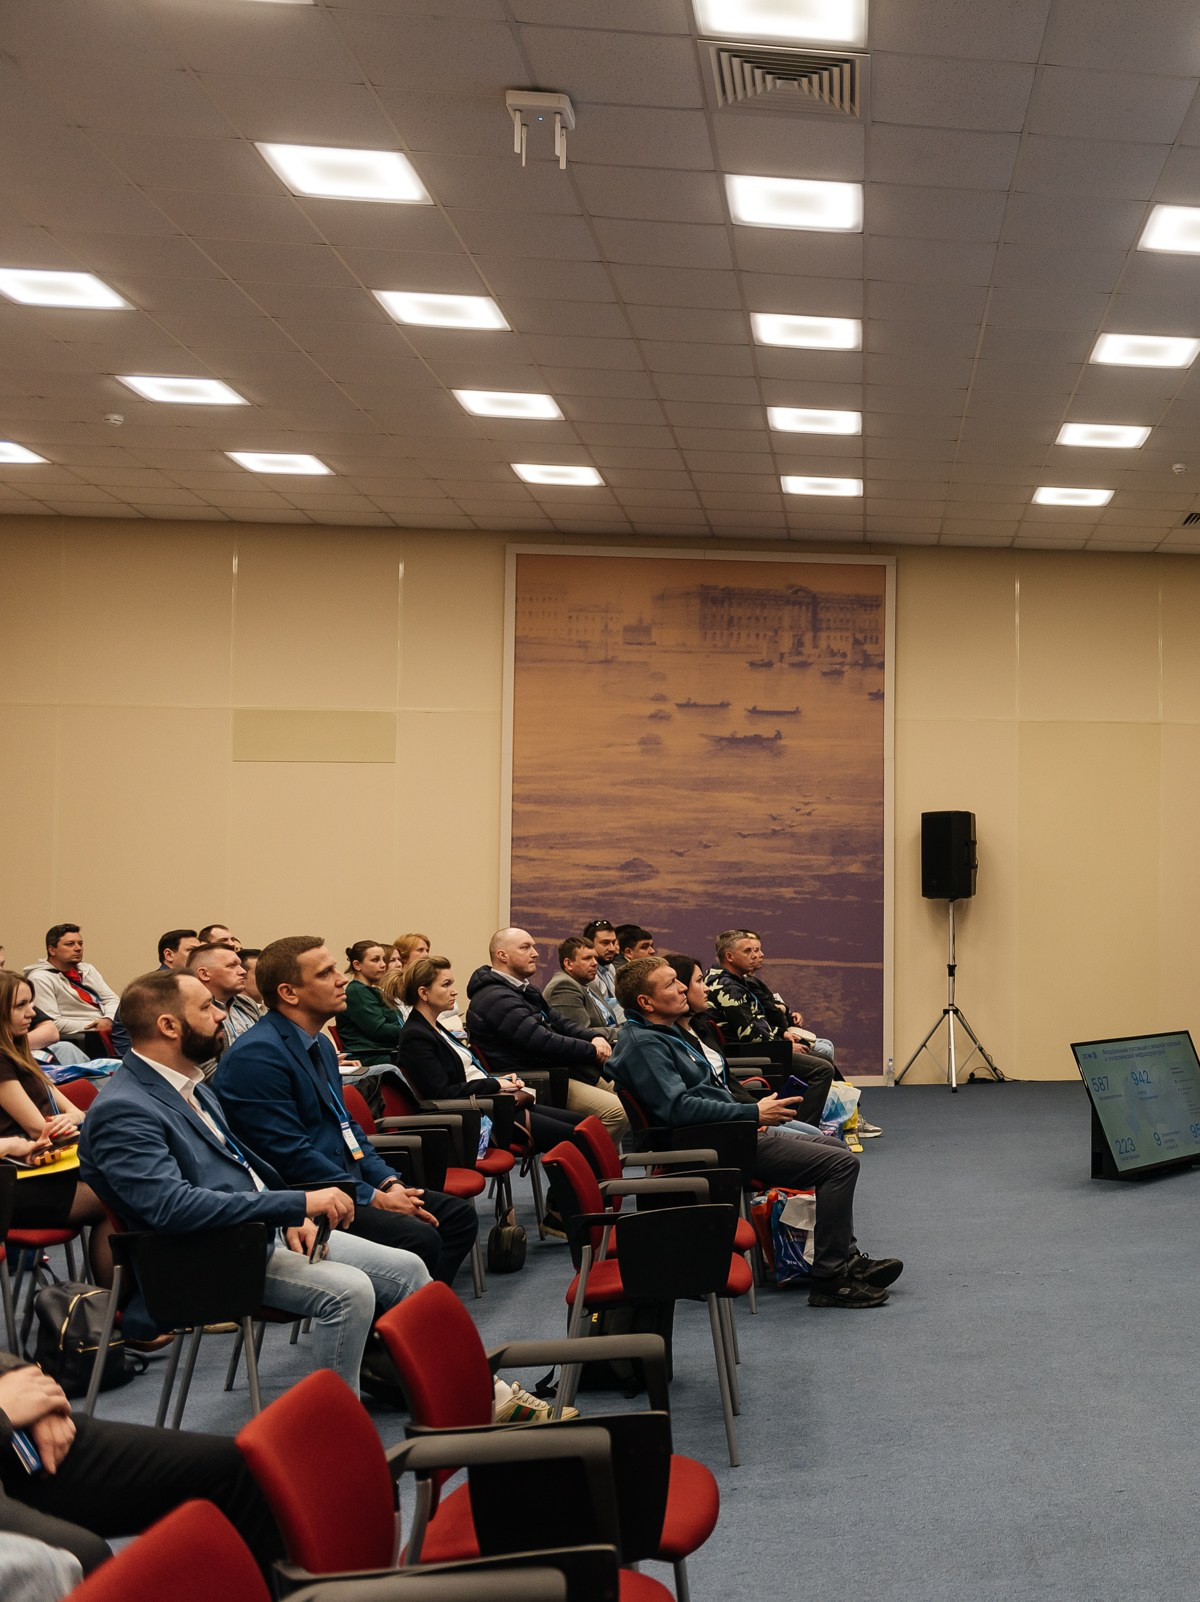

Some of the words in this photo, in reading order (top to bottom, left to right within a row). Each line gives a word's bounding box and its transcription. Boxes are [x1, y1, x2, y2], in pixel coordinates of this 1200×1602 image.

[1091, 1076, 1110, 1092] 587
[1131, 1070, 1152, 1086] 942
[1115, 1137, 1136, 1155] 223
[1153, 1131, 1162, 1147] 9
